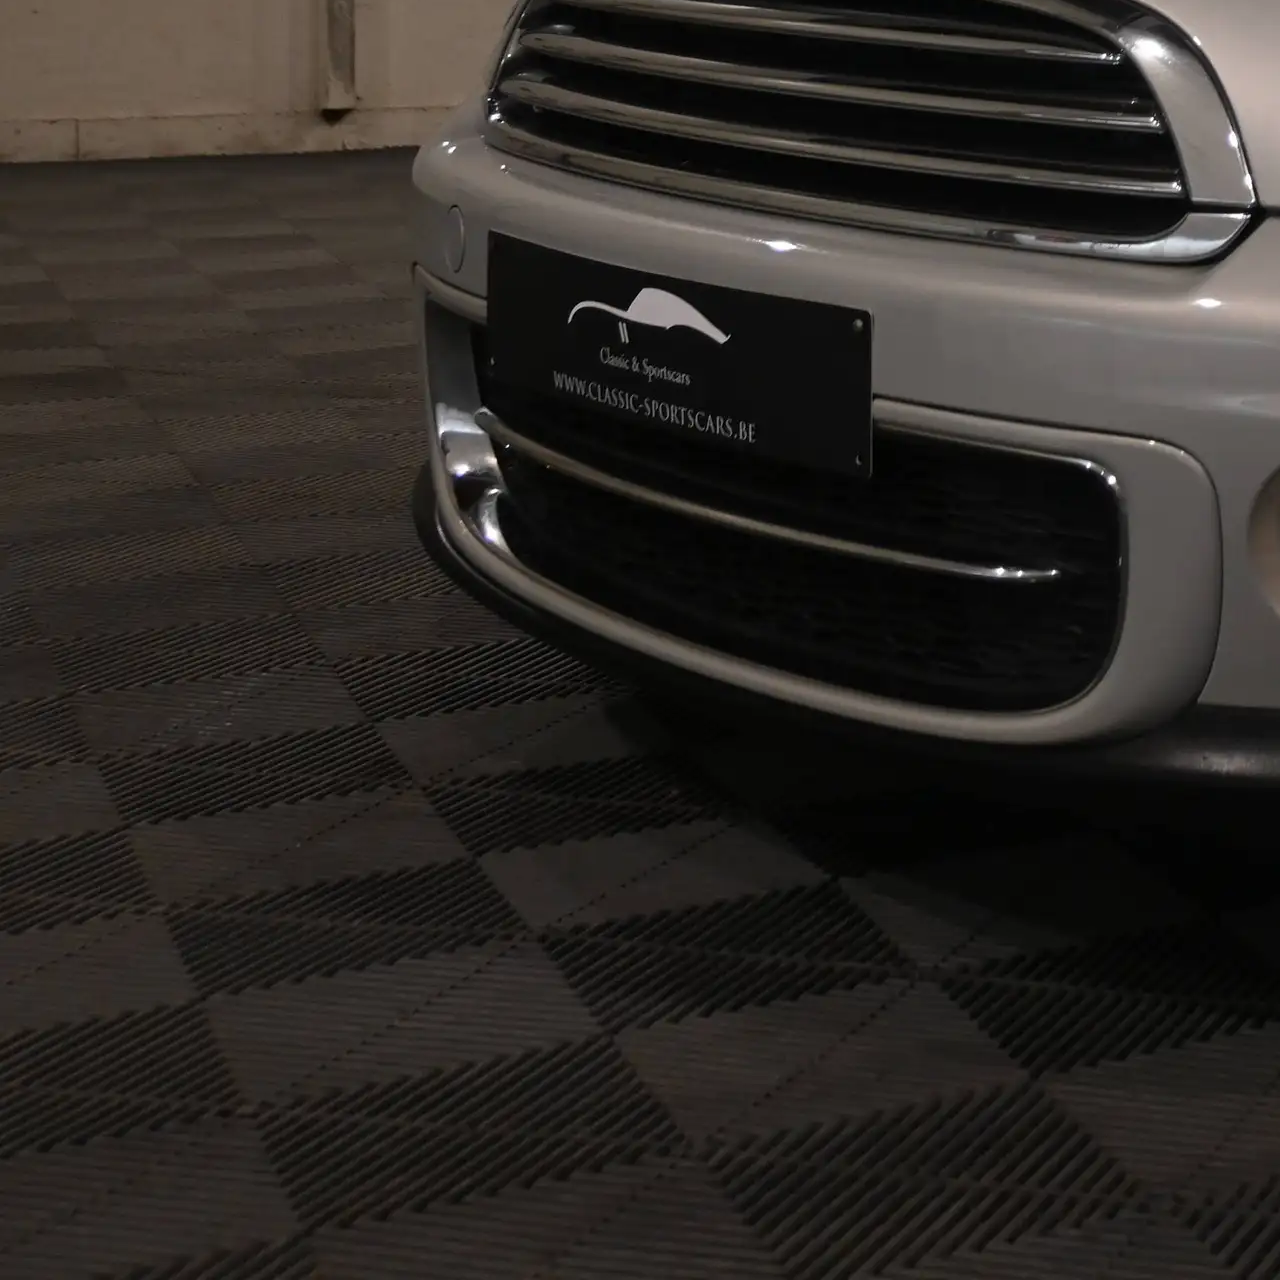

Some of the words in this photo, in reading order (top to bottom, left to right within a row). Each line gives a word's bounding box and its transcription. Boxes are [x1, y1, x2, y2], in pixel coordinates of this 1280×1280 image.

[600, 346, 630, 370] Classic
[631, 355, 642, 374] &
[642, 357, 692, 387] Sportscars
[553, 370, 757, 444] WWW.CLASSIC-SPORTSCARS.BE
